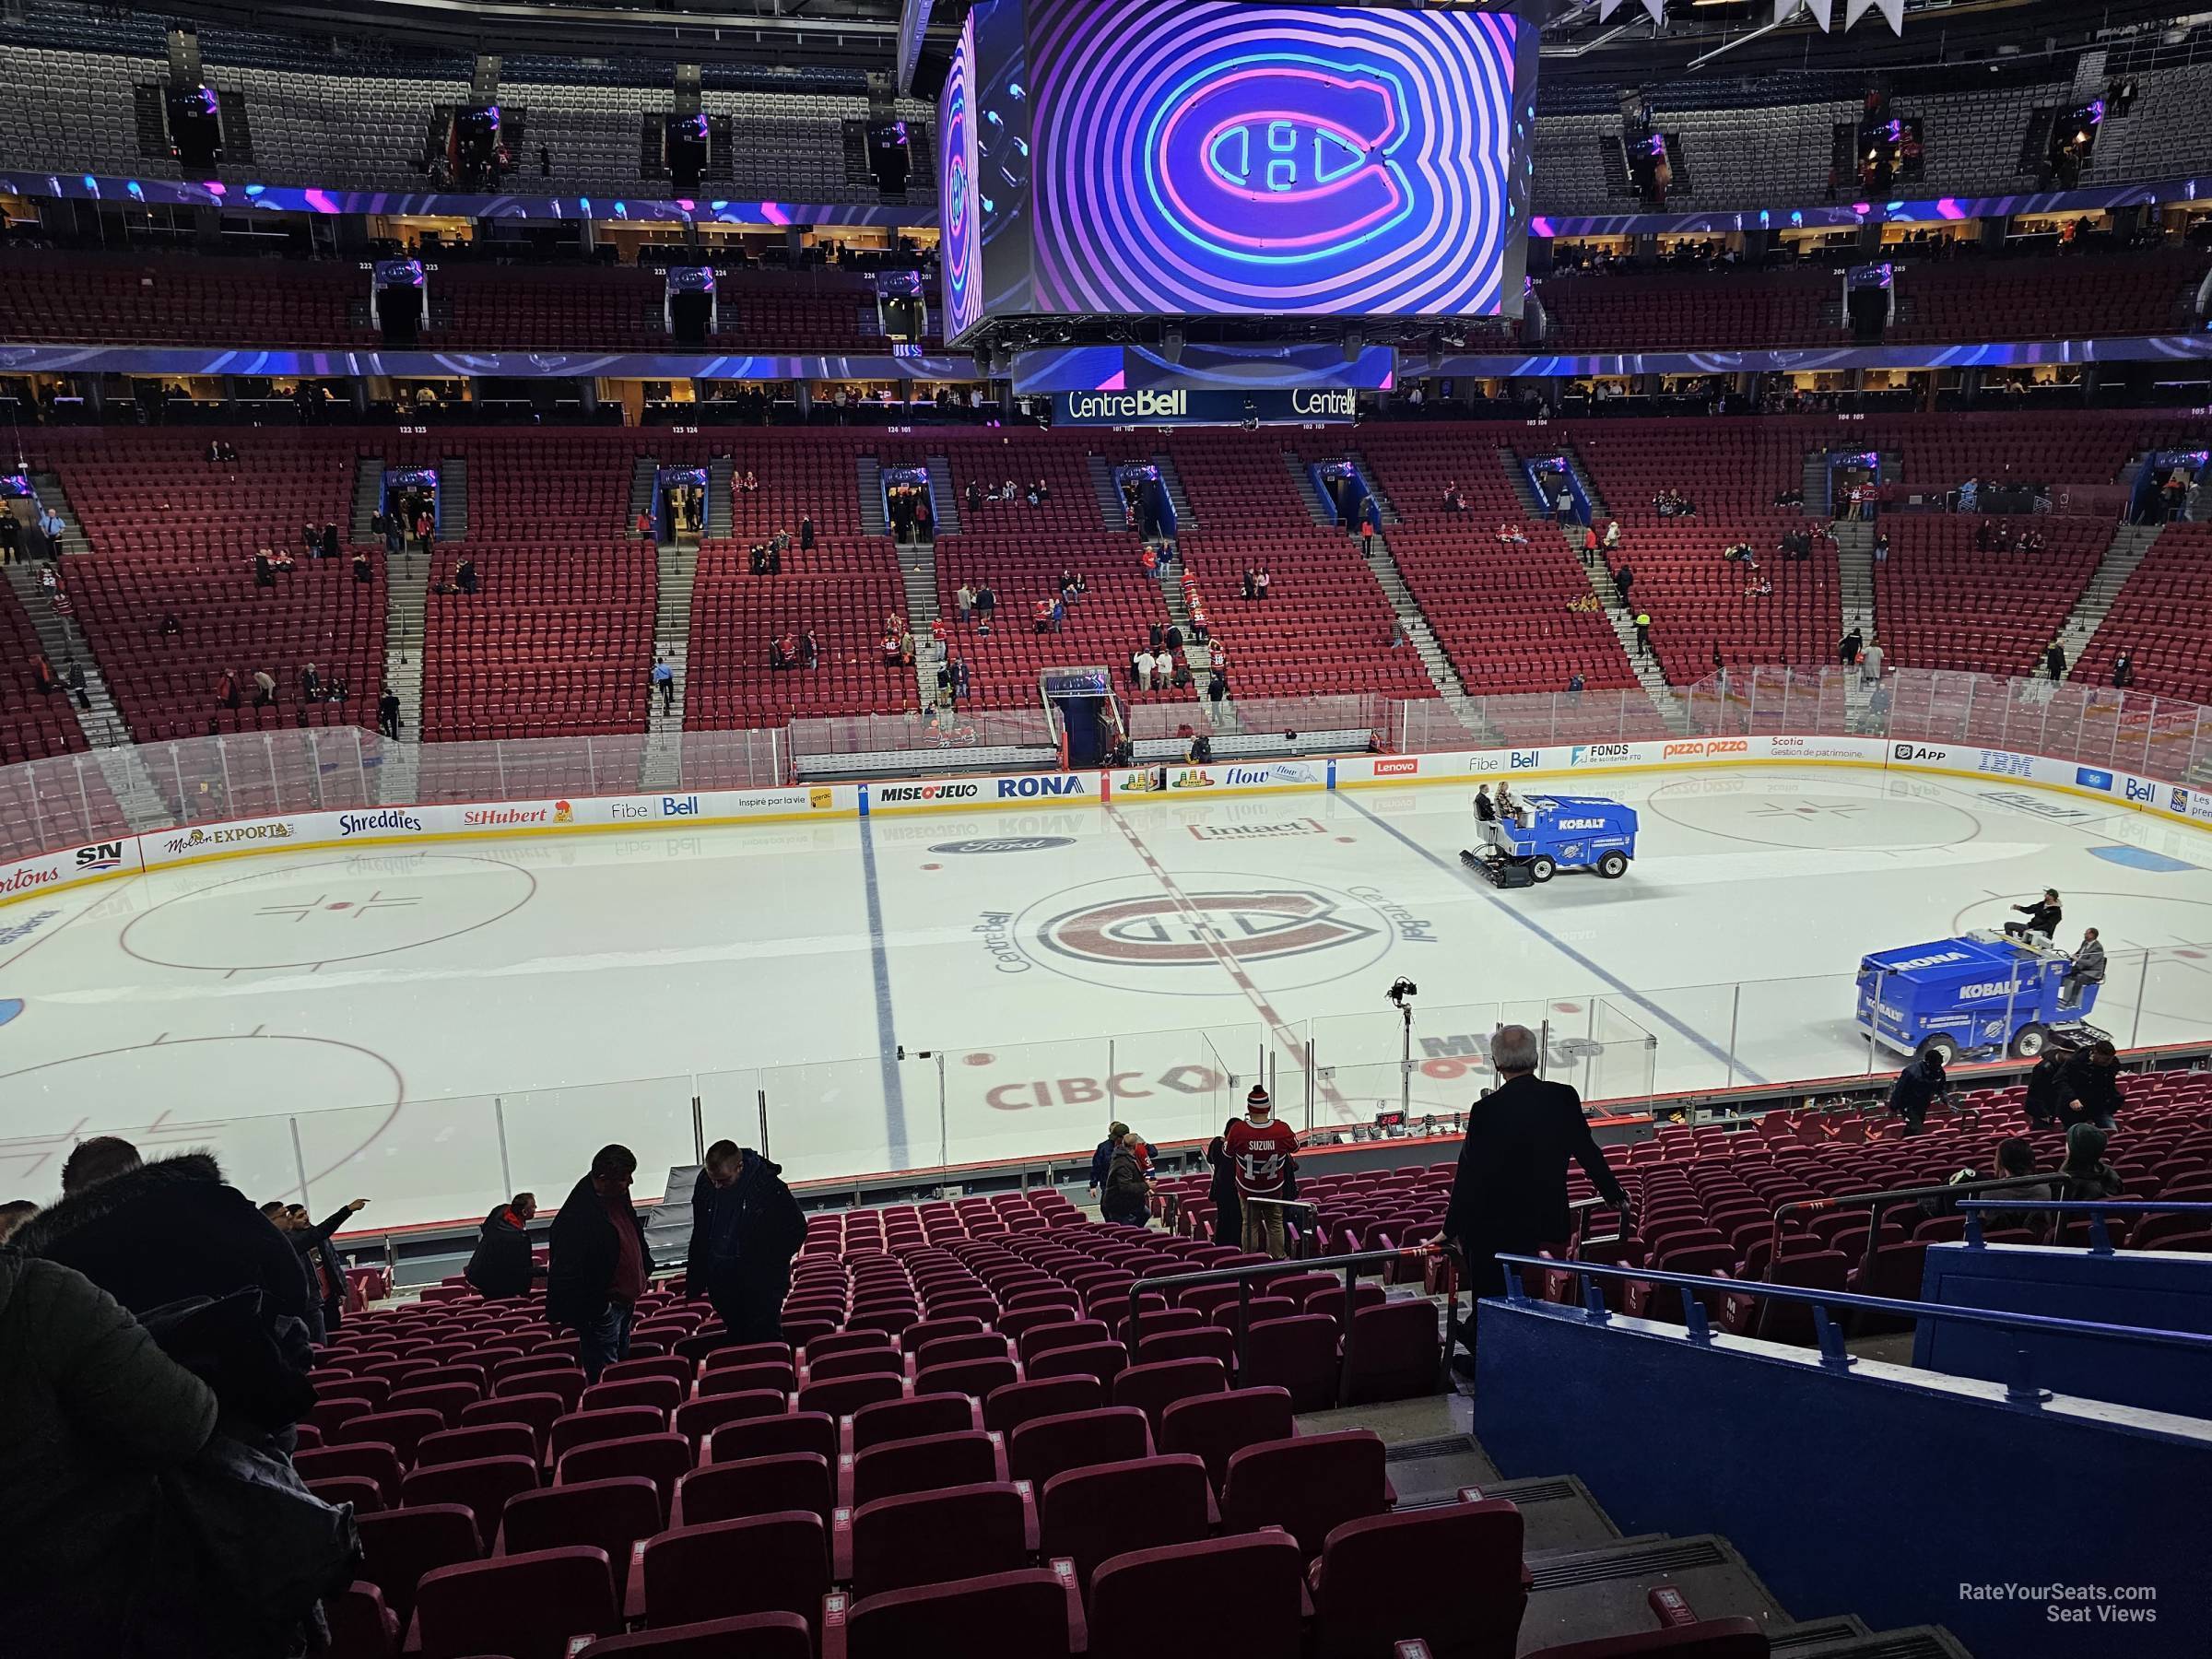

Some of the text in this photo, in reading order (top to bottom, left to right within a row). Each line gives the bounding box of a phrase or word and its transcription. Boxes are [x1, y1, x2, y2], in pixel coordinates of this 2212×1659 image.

[1069, 390, 1186, 418] CentreBell
[1591, 744, 1630, 757] FONDS
[1664, 740, 1747, 760] pizza pizza
[1771, 737, 1804, 746] Scotia
[1469, 750, 1539, 771] Fibe Bell
[1771, 747, 1802, 756] Gestion
[1804, 748, 1815, 757] de
[1377, 762, 1415, 772] Lenovo
[1978, 750, 2035, 778] IBM
[1226, 768, 1269, 784] flow
[2088, 774, 2101, 783] 5G
[997, 776, 1084, 798] RONA
[2124, 778, 2157, 803] Bell
[612, 795, 699, 818] Fibe Bell
[739, 797, 766, 808] Inspiré
[768, 797, 782, 807] par
[2171, 804, 2186, 812] RBC
[2194, 794, 2210, 806] Les
[339, 809, 421, 836] Shreddies
[1206, 821, 1309, 836] intact
[1559, 818, 1606, 830] KOBALT
[164, 834, 213, 853] Molson
[959, 839, 1047, 853] Ford
[76, 841, 123, 865] SN
[1888, 951, 1972, 971] RONA
[1959, 979, 2022, 1000] KOBALT
[985, 1071, 1155, 1112] CIBC
[1248, 1139, 1276, 1151] SUZUKI
[1243, 1153, 1279, 1181] 14
[1725, 1297, 1736, 1314] M
